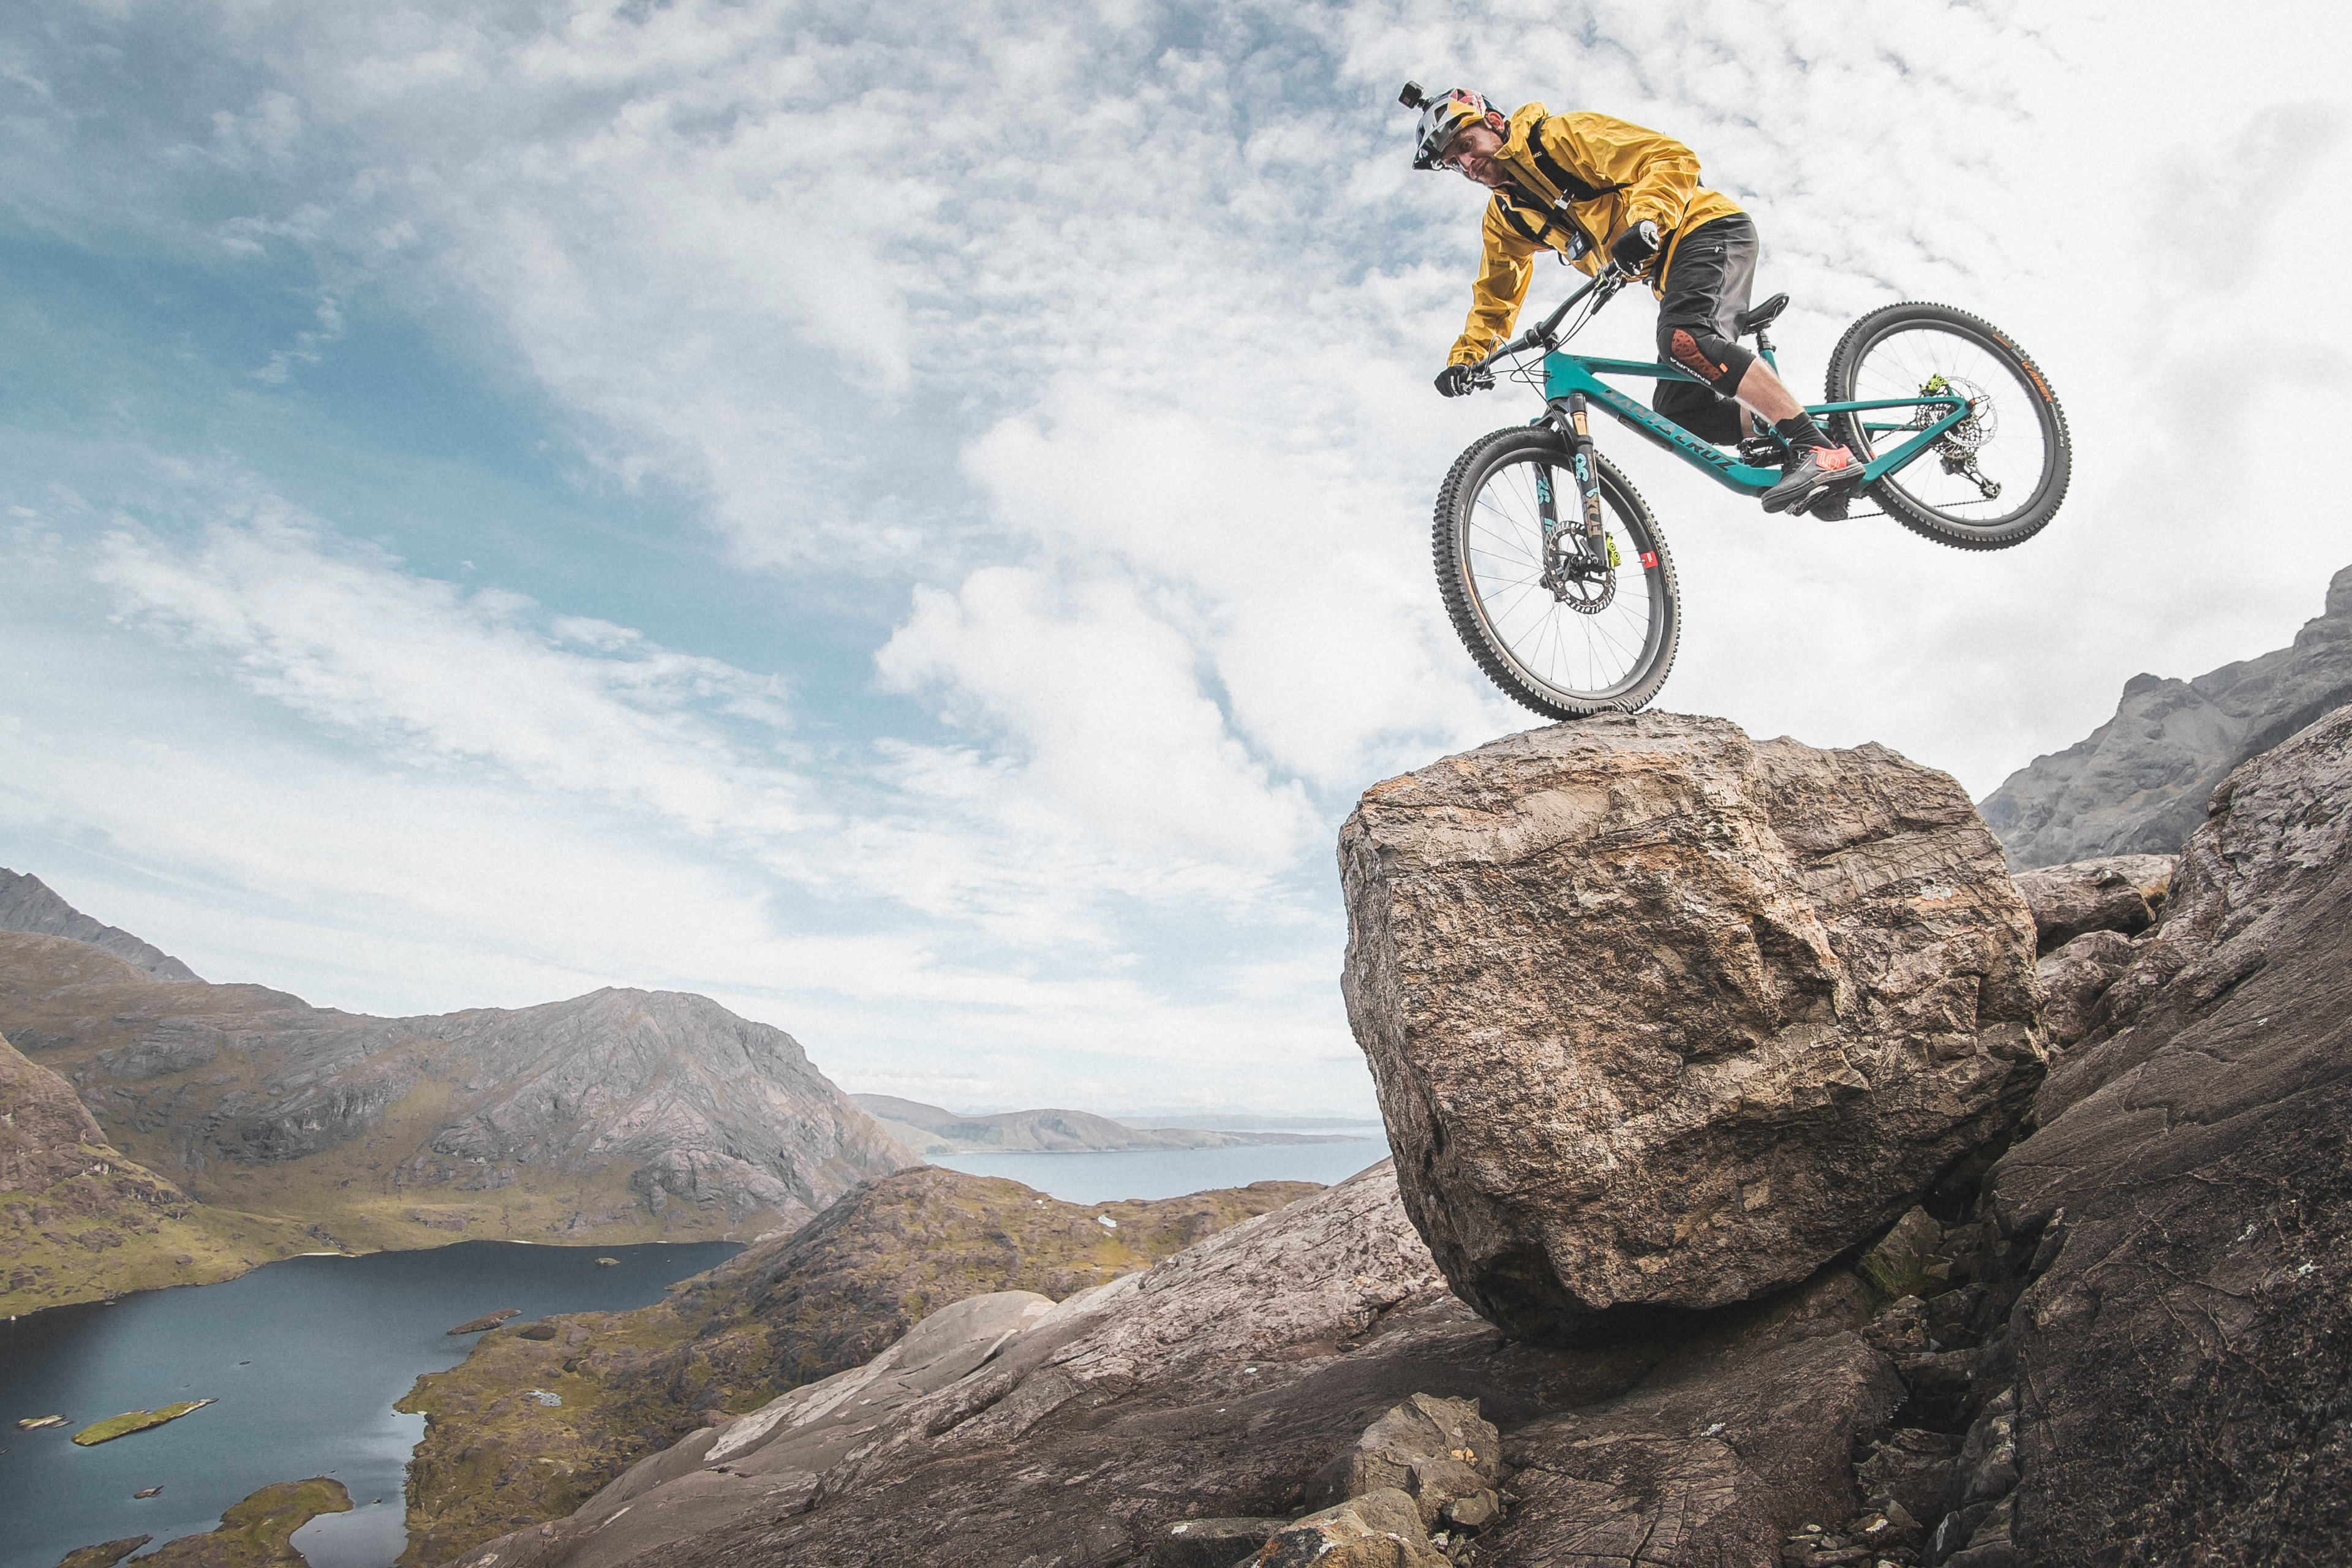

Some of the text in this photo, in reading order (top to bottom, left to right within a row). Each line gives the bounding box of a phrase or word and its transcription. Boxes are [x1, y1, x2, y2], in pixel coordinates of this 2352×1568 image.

[1670, 356, 1711, 386] ENDURA
[2022, 361, 2052, 402] KAISER
[1599, 389, 1737, 472] SANTA CRUZ
[1646, 518, 1674, 597] CONTINENTAL
